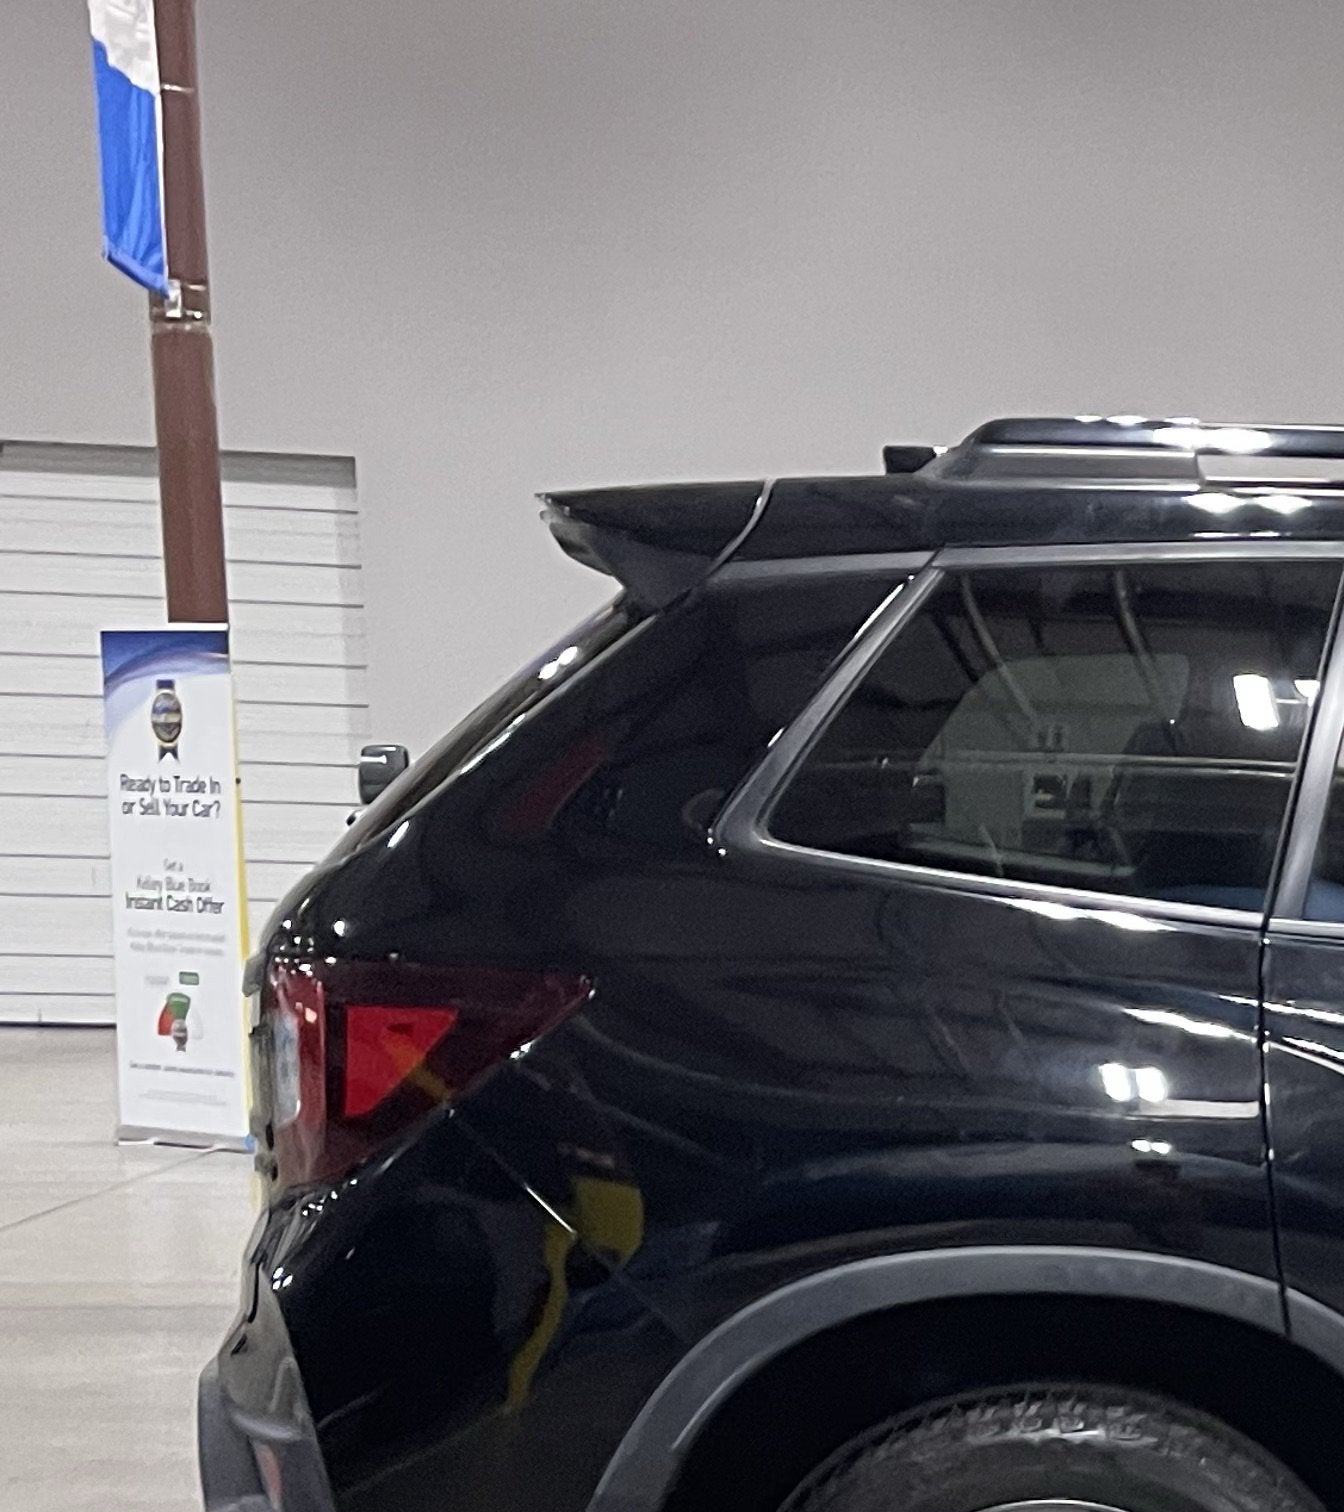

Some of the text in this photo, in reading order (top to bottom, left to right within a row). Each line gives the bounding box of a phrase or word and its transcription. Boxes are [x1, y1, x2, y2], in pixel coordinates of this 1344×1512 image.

[120, 773, 222, 796] Ready to Trade In
[122, 797, 221, 818] or Sell Your Car?
[166, 895, 194, 912] Cash
